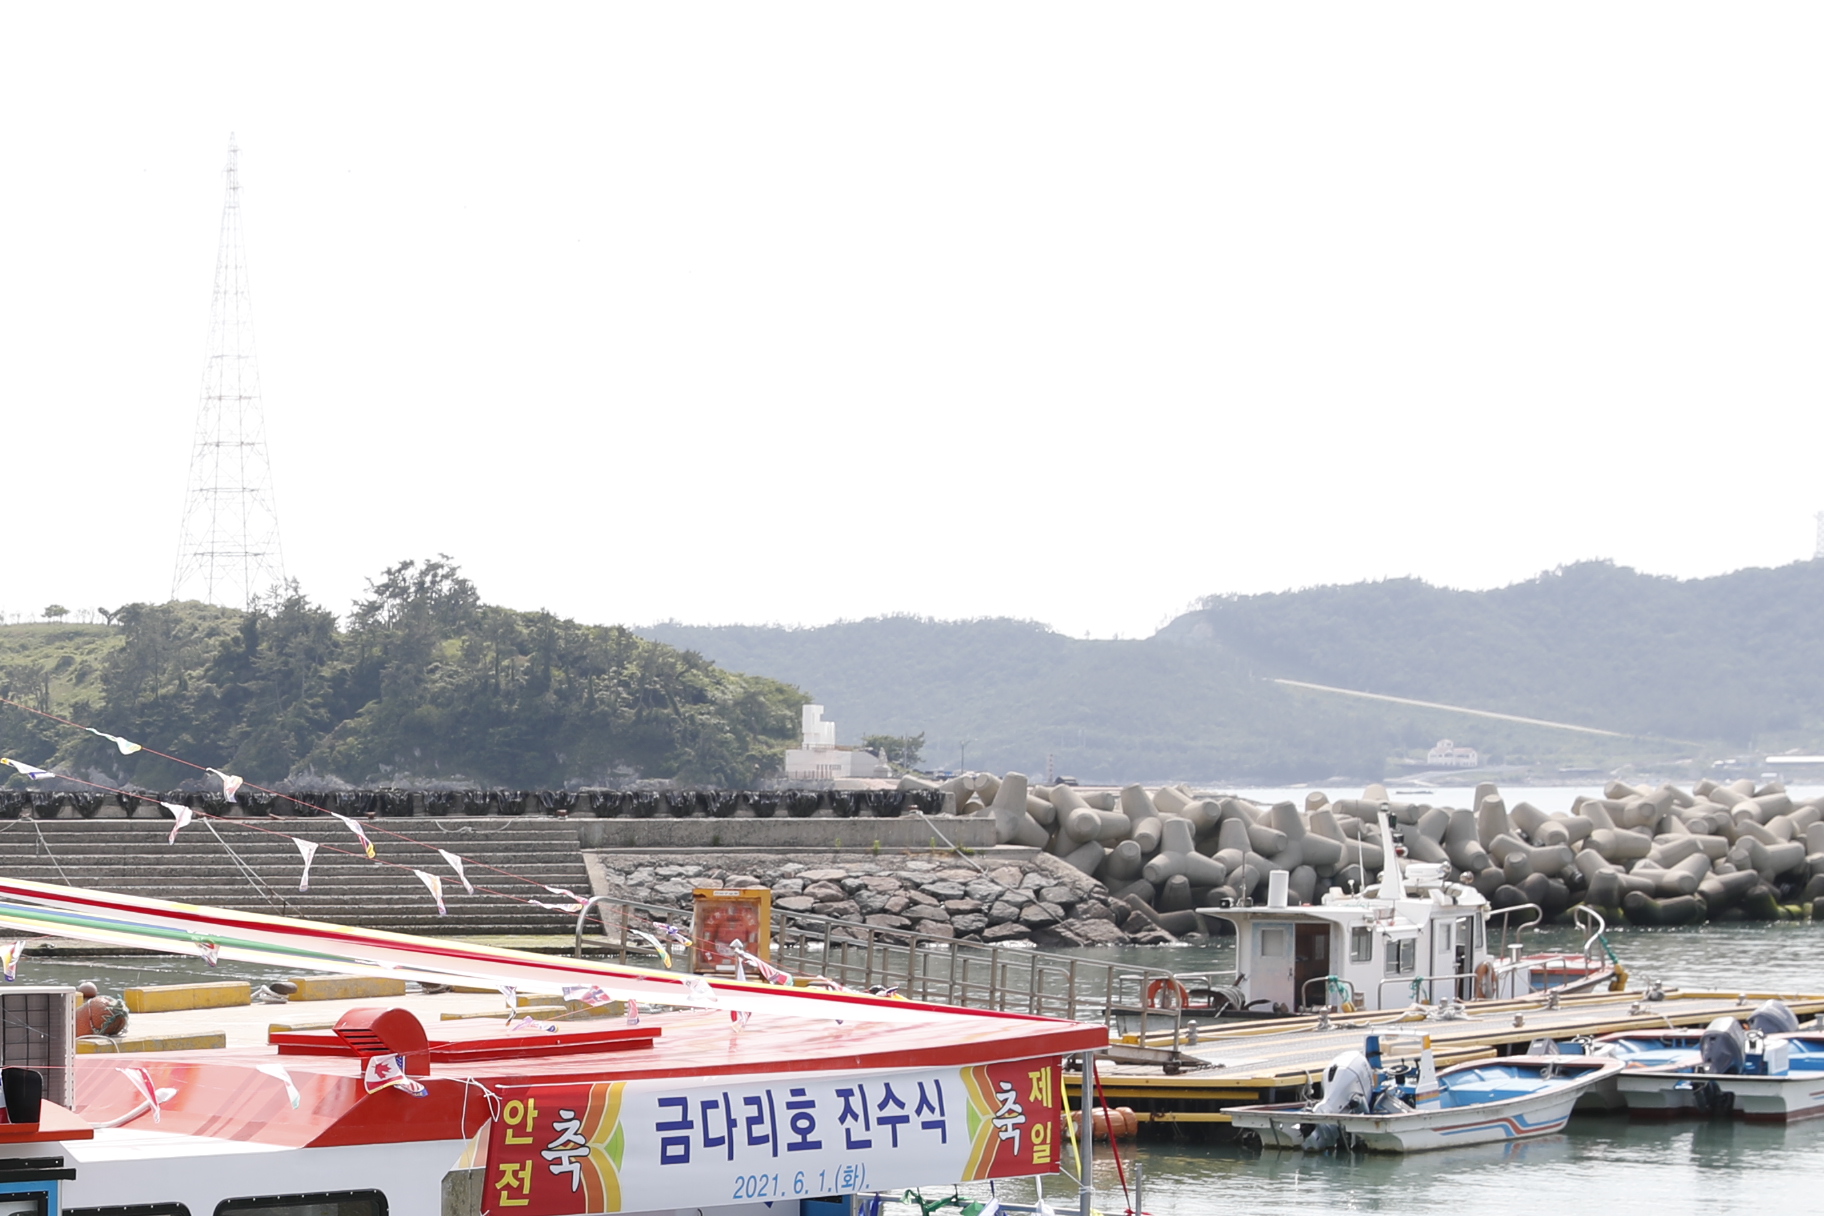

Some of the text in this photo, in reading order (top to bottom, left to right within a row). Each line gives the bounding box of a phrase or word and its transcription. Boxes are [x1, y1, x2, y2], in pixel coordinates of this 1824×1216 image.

[493, 1096, 538, 1208] 안전
[540, 1108, 591, 1193] 축
[655, 1076, 948, 1165] 금다리호 진수식
[991, 1080, 1027, 1157] 축
[1026, 1065, 1054, 1165] 제일
[733, 1173, 786, 1199] 2021.
[793, 1170, 809, 1195] 6.
